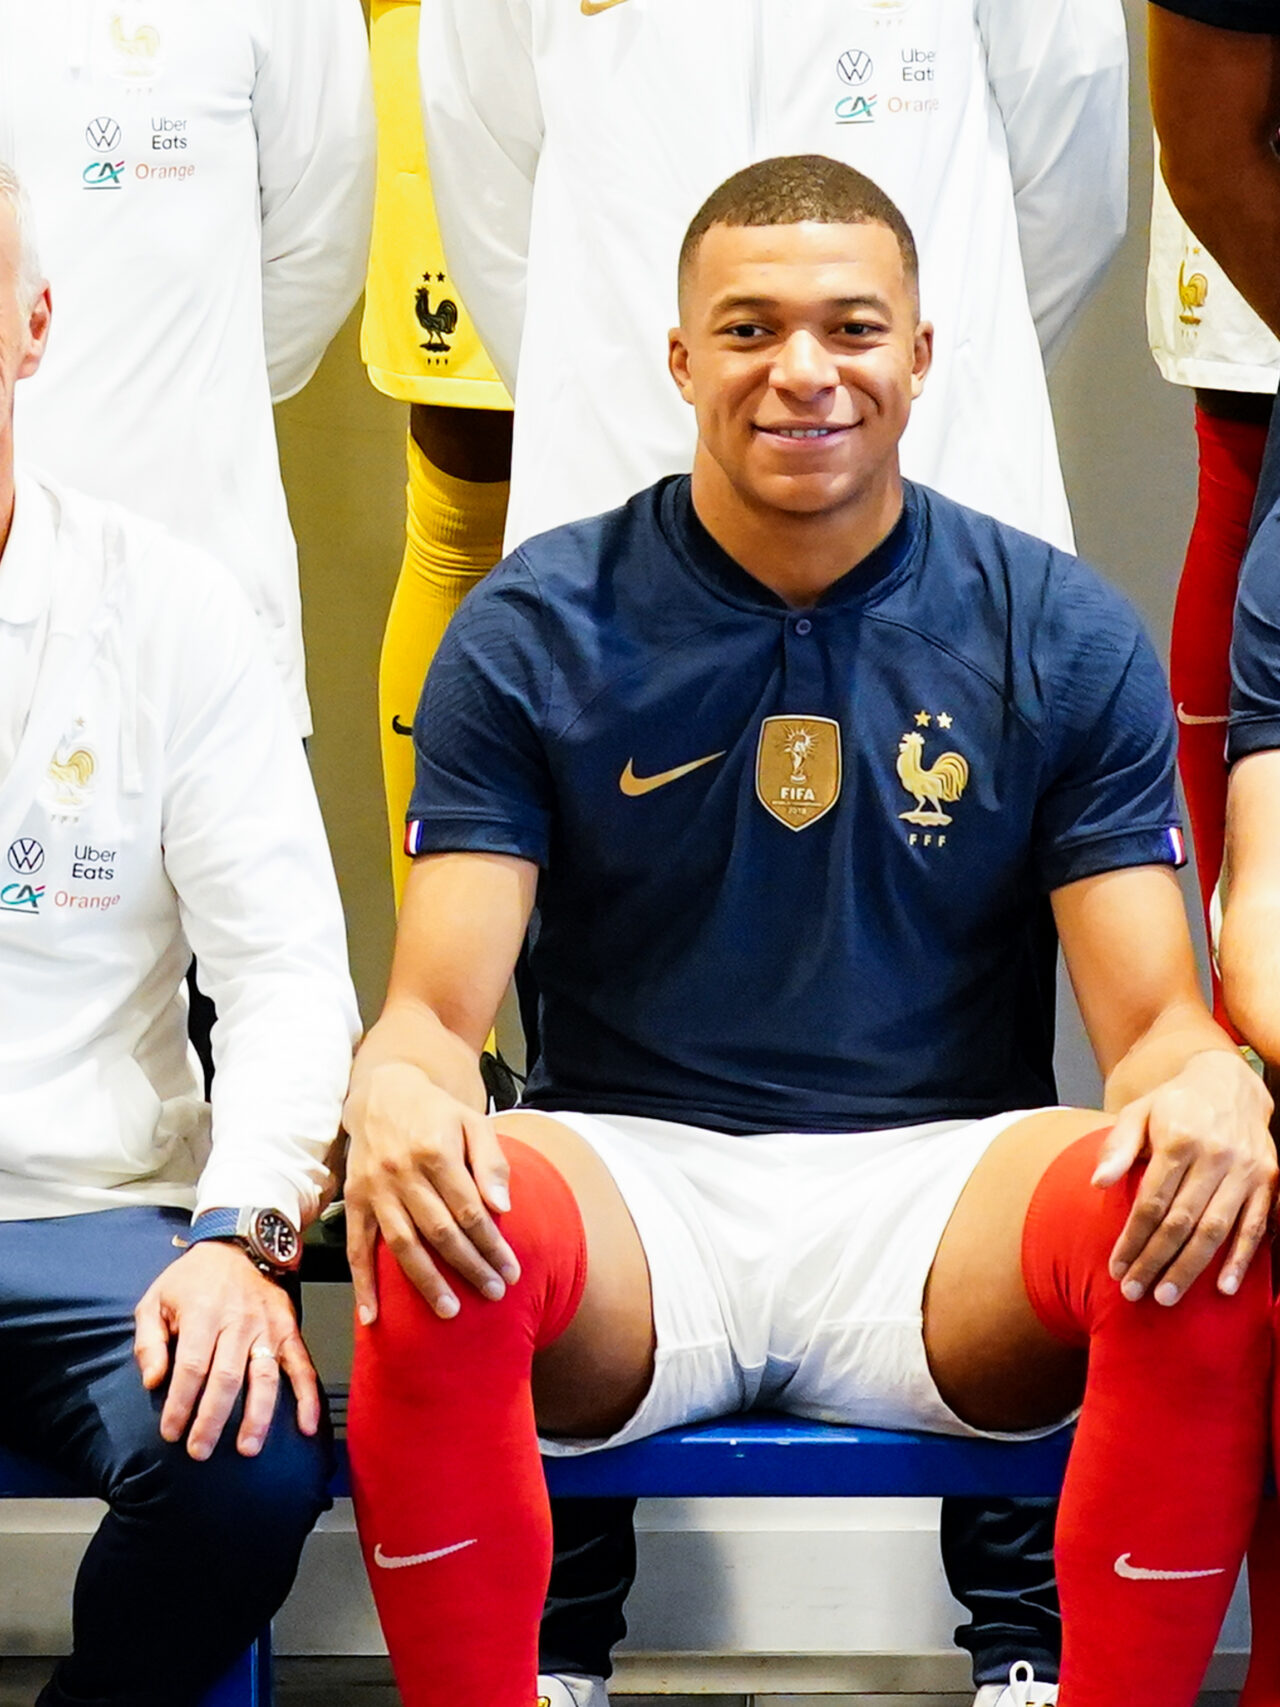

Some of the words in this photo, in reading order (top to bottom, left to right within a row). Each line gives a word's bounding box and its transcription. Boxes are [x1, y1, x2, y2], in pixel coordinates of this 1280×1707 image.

[901, 48, 937, 63] Ube
[151, 117, 188, 132] Uber
[151, 134, 188, 151] Eats
[135, 163, 196, 181] Orange
[780, 786, 816, 801] FIFA
[74, 844, 118, 863] Uber
[71, 862, 115, 881] Eats
[54, 890, 121, 912] Orange
